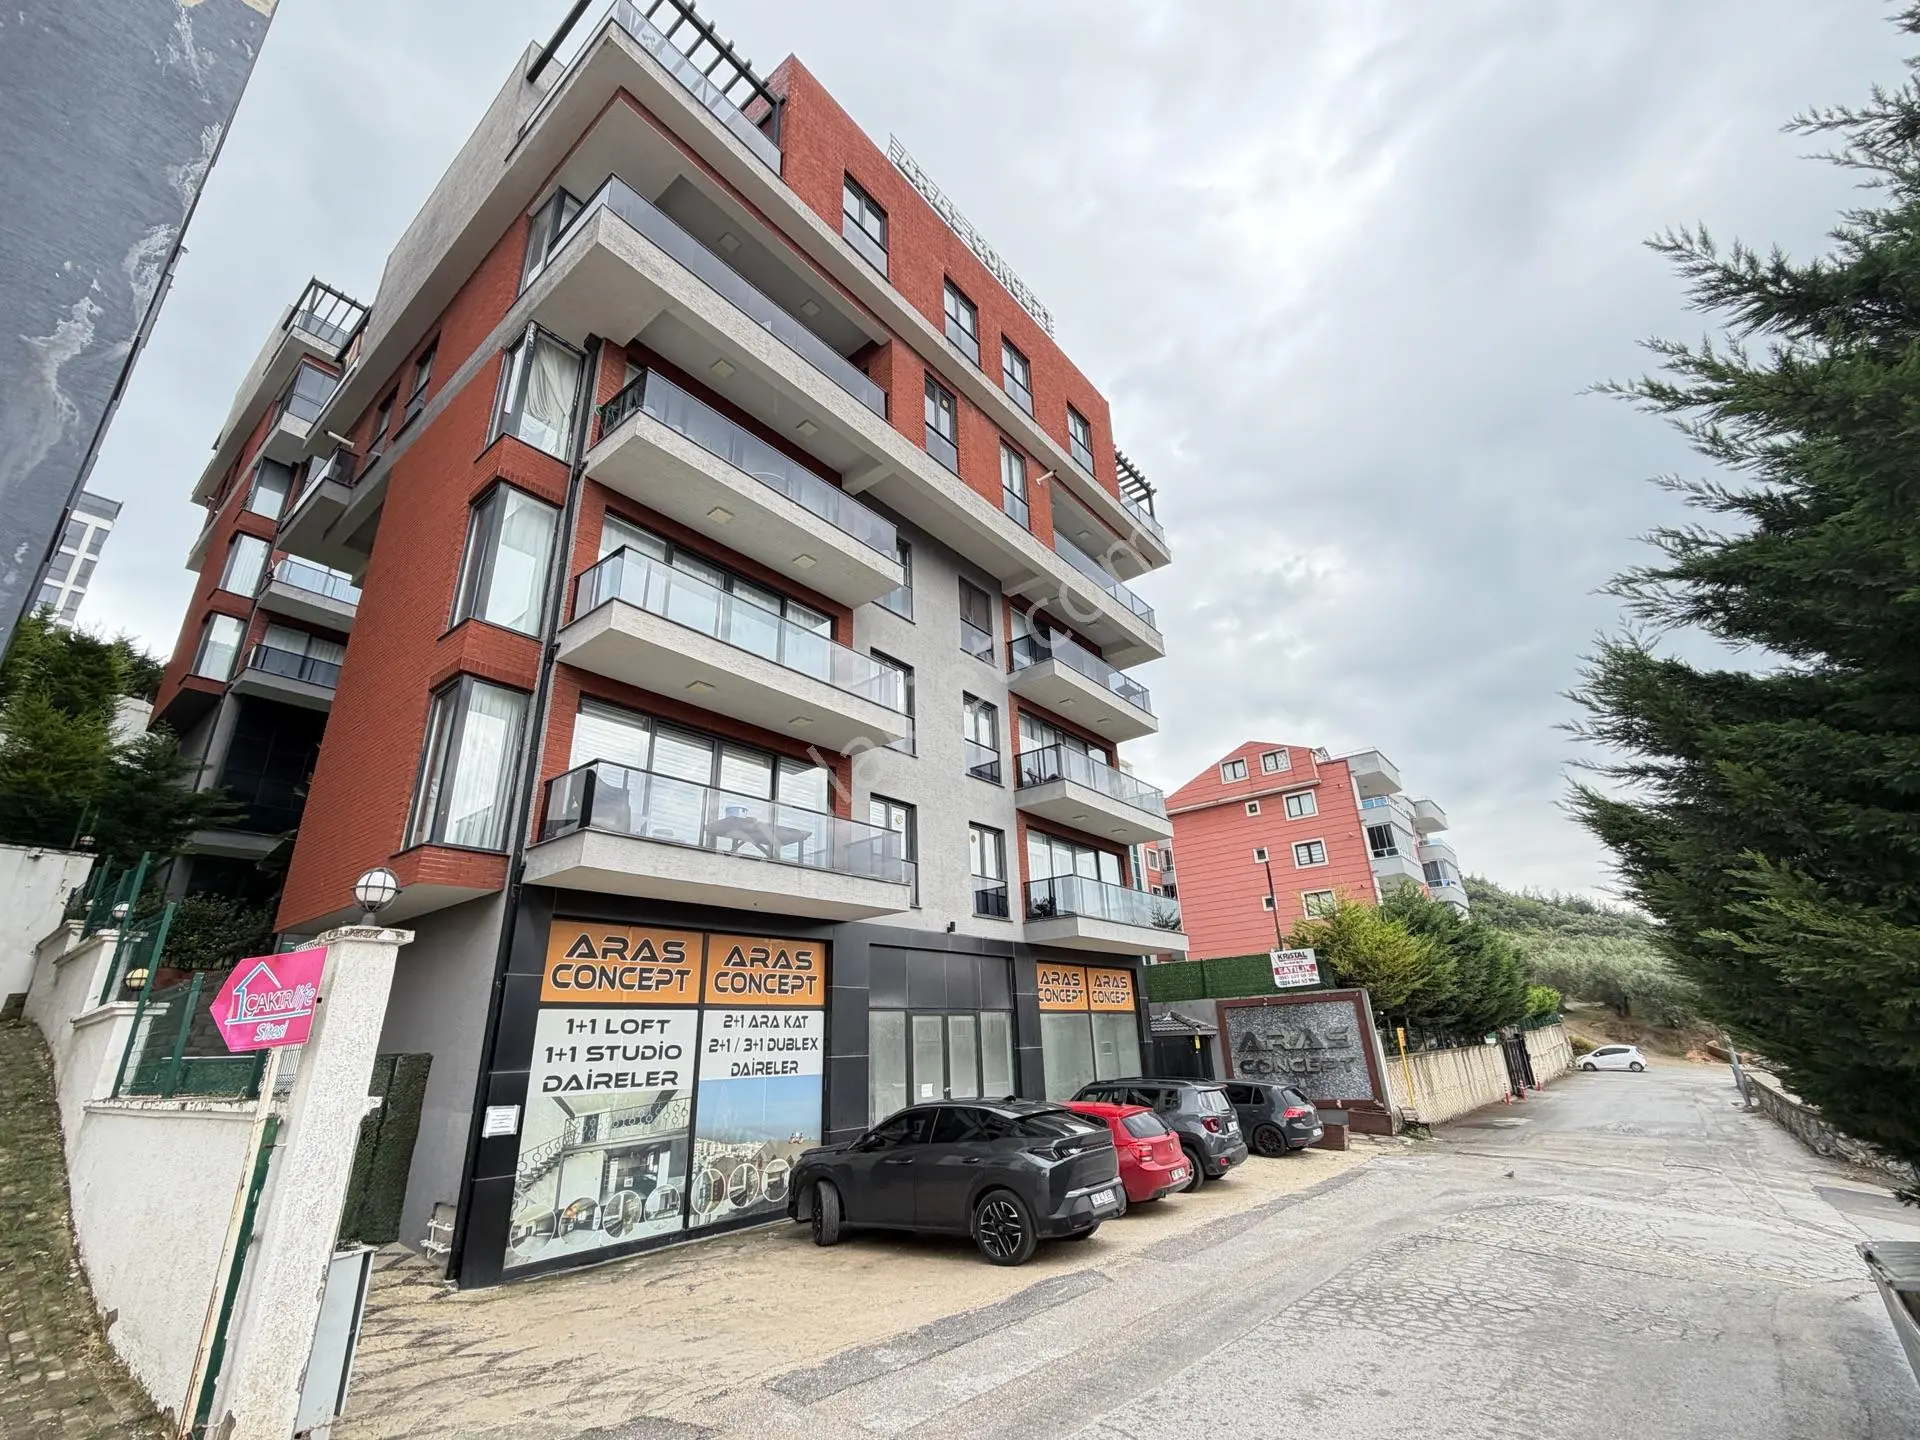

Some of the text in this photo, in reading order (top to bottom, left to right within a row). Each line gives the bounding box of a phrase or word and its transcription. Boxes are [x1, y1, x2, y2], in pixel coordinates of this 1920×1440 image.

[564, 933, 687, 964] ARAS
[723, 945, 814, 971] ARAS
[551, 963, 691, 992] CONCEPT
[713, 971, 818, 996] CONCEPT
[1040, 970, 1081, 987] ARAS
[1094, 974, 1128, 989] ARAS
[1037, 987, 1084, 1003] CONCEPT
[1091, 990, 1131, 1004] CONCEPT
[566, 1018, 672, 1035] 1+1 LOFT
[723, 1014, 809, 1029] 2+1 ARA KAT
[708, 1038, 731, 1053] 2+1
[743, 1037, 763, 1052] 3+1
[767, 1037, 819, 1052] DUBLEX
[1238, 1025, 1351, 1053] ARAS
[545, 1041, 683, 1064] 1+1 STUDİO
[730, 1057, 799, 1077] DAİRELER
[1239, 1056, 1356, 1074] CONCEPT
[542, 1069, 679, 1093] DAİRELER
